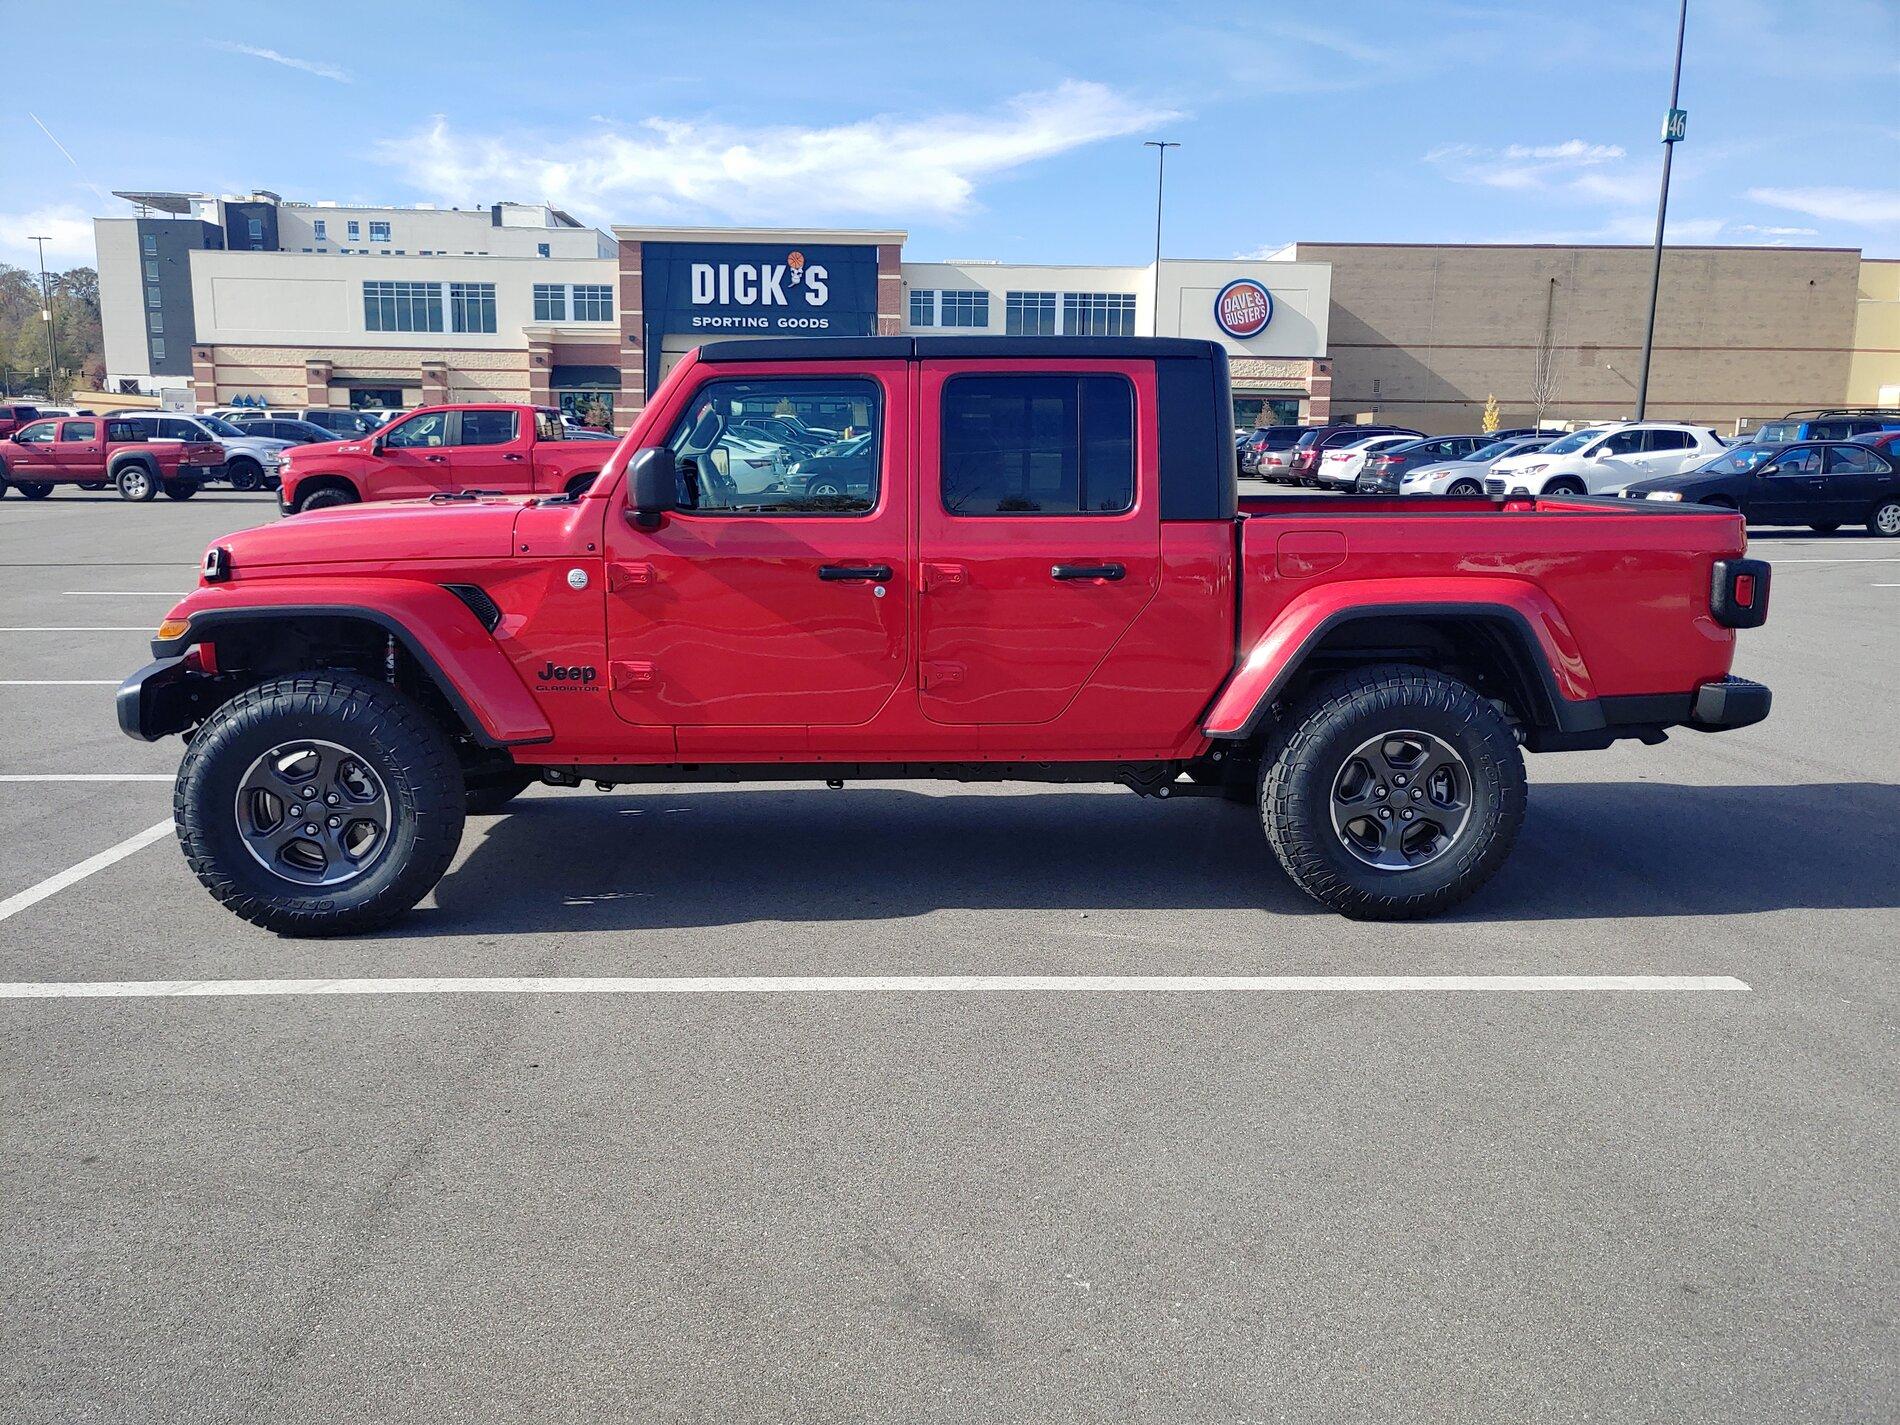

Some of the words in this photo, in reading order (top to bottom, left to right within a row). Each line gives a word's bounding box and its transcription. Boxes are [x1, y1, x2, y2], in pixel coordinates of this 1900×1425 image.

[1669, 113, 1686, 138] 46
[691, 262, 829, 307] DICK'S
[1224, 292, 1255, 314] DAVE
[1254, 291, 1265, 306] &
[692, 316, 769, 328] SPORTING
[777, 317, 830, 329] GOODS
[1225, 305, 1266, 326] BUSTER'S
[538, 661, 597, 684] Jeep
[535, 685, 600, 693] GLADIATOR
